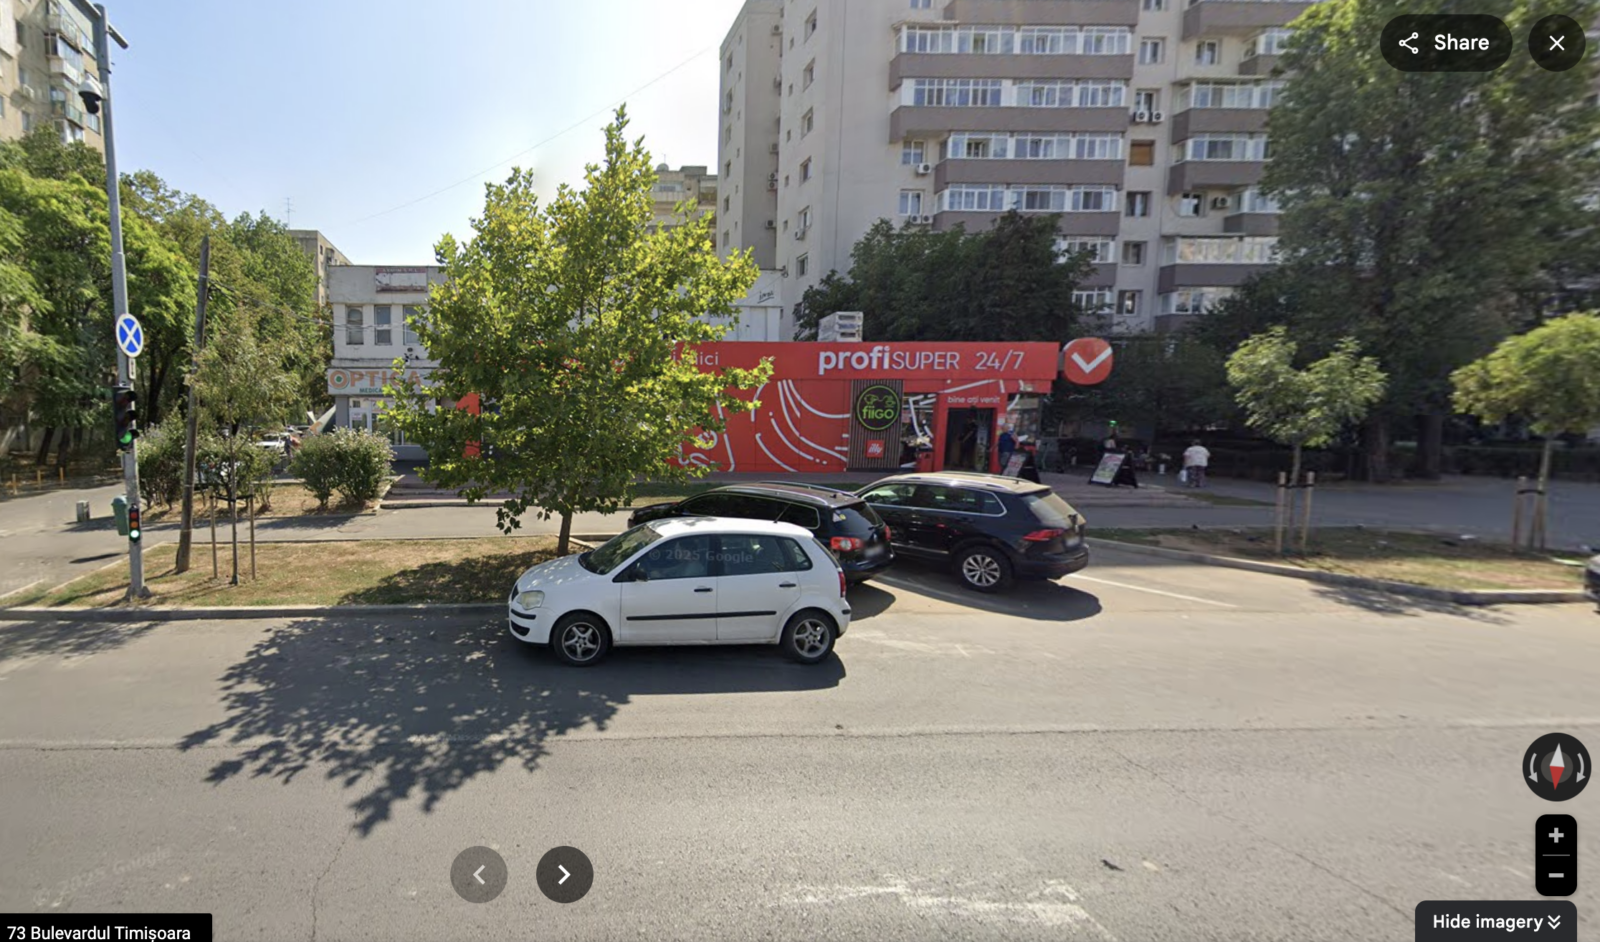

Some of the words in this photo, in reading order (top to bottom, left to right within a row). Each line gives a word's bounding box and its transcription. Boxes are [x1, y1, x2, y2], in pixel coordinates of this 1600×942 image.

[975, 350, 1025, 372] 24/7
[329, 370, 421, 389] OPTICA
[947, 395, 965, 404] bine
[980, 395, 1001, 404] venit
